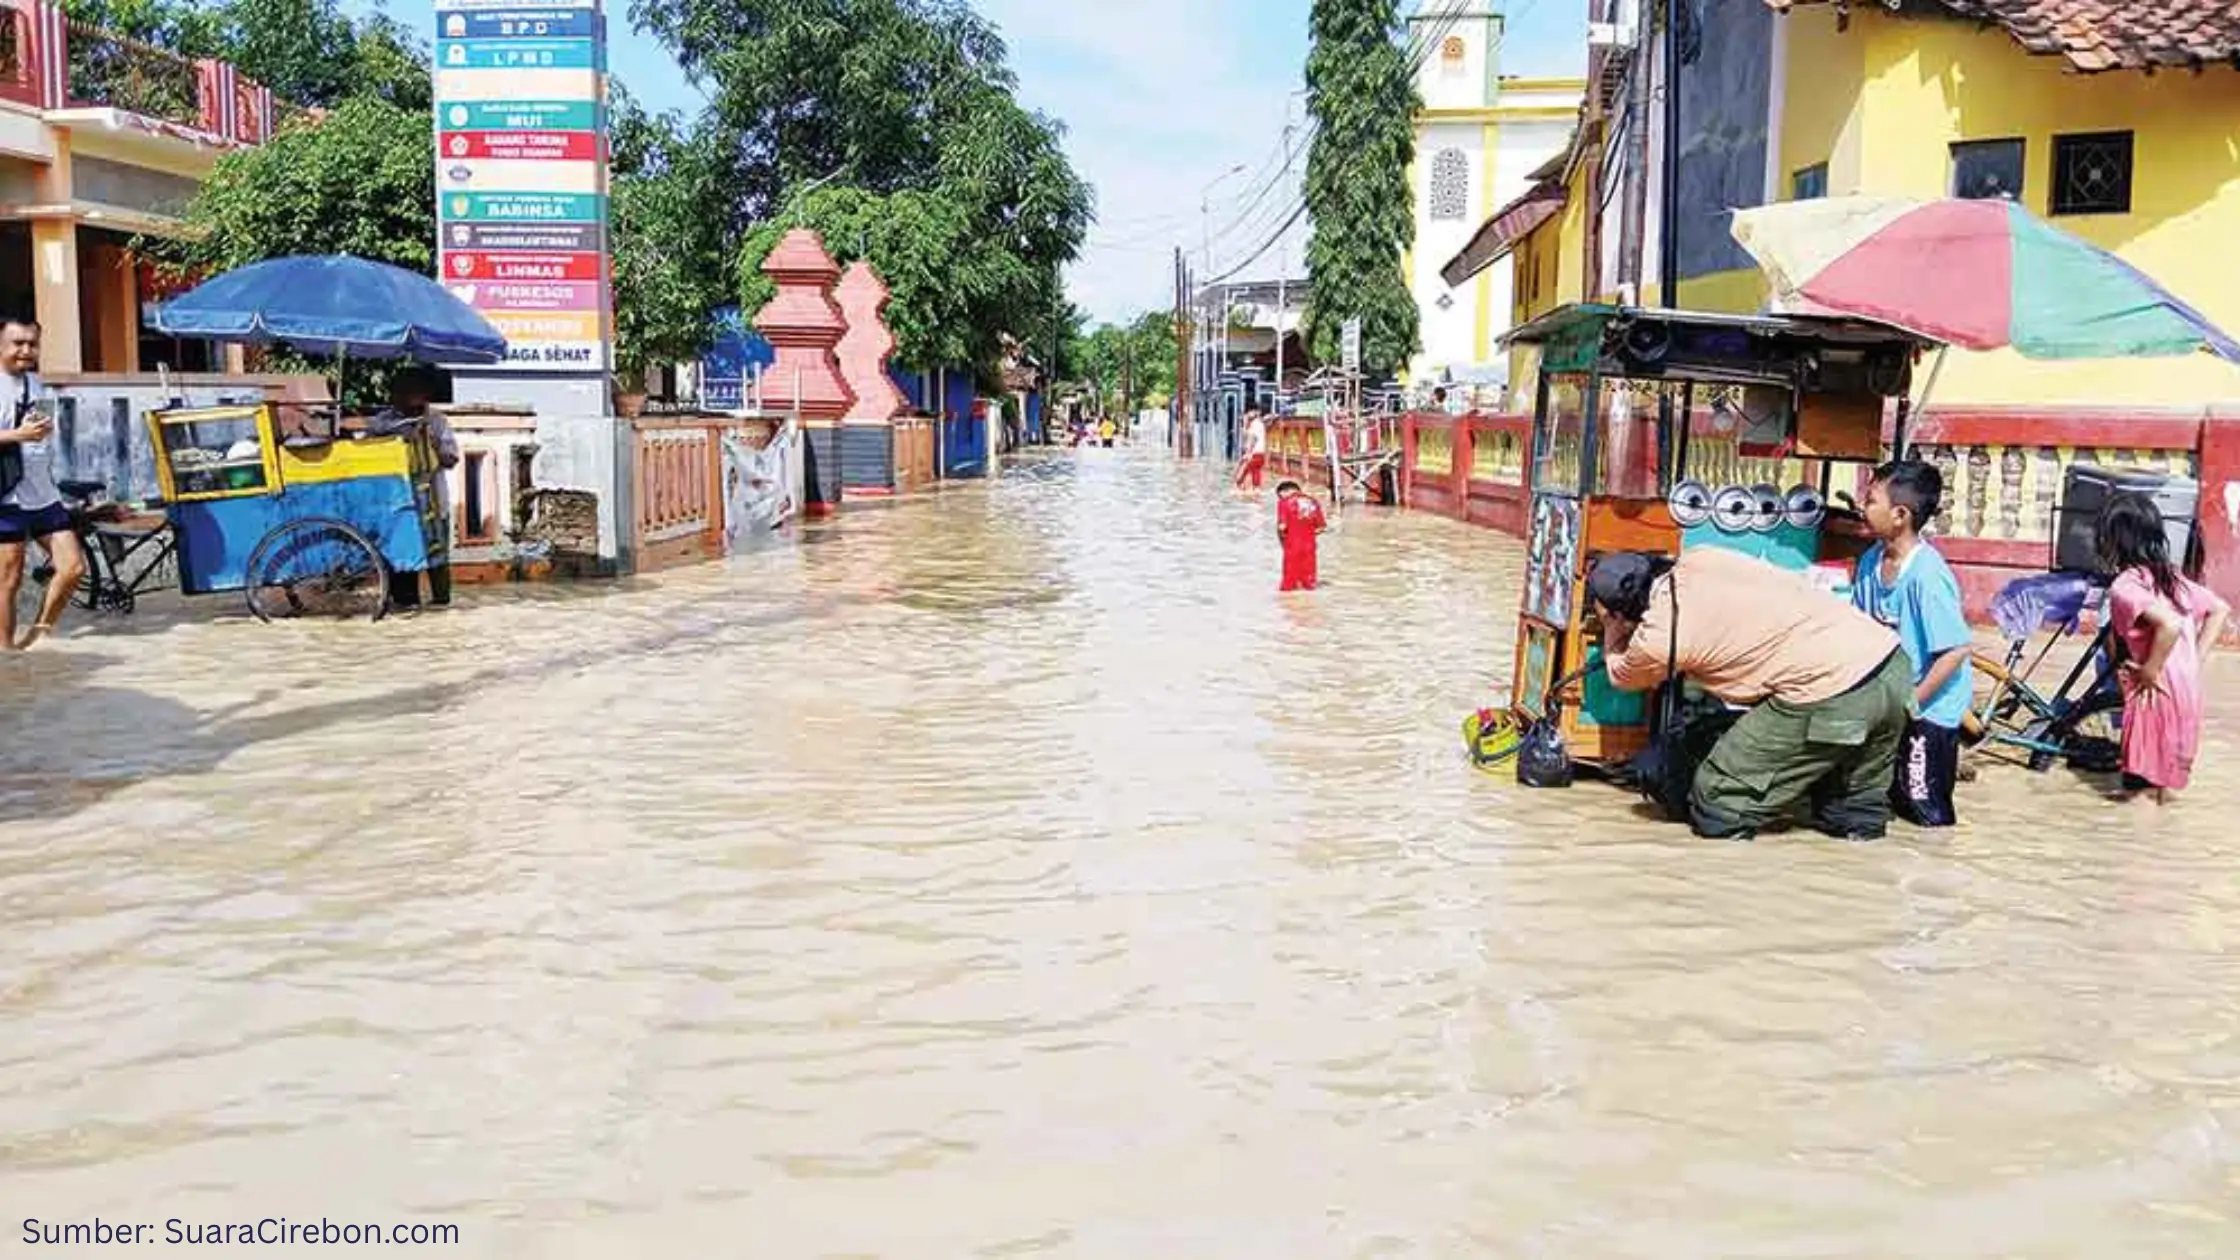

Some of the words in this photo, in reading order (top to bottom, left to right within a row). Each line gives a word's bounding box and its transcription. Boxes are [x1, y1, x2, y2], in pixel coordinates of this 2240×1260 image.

[507, 115, 543, 127] MUI
[487, 203, 565, 217] BABINSA
[496, 265, 565, 278] LINMAS
[545, 347, 591, 361] SEHAT
